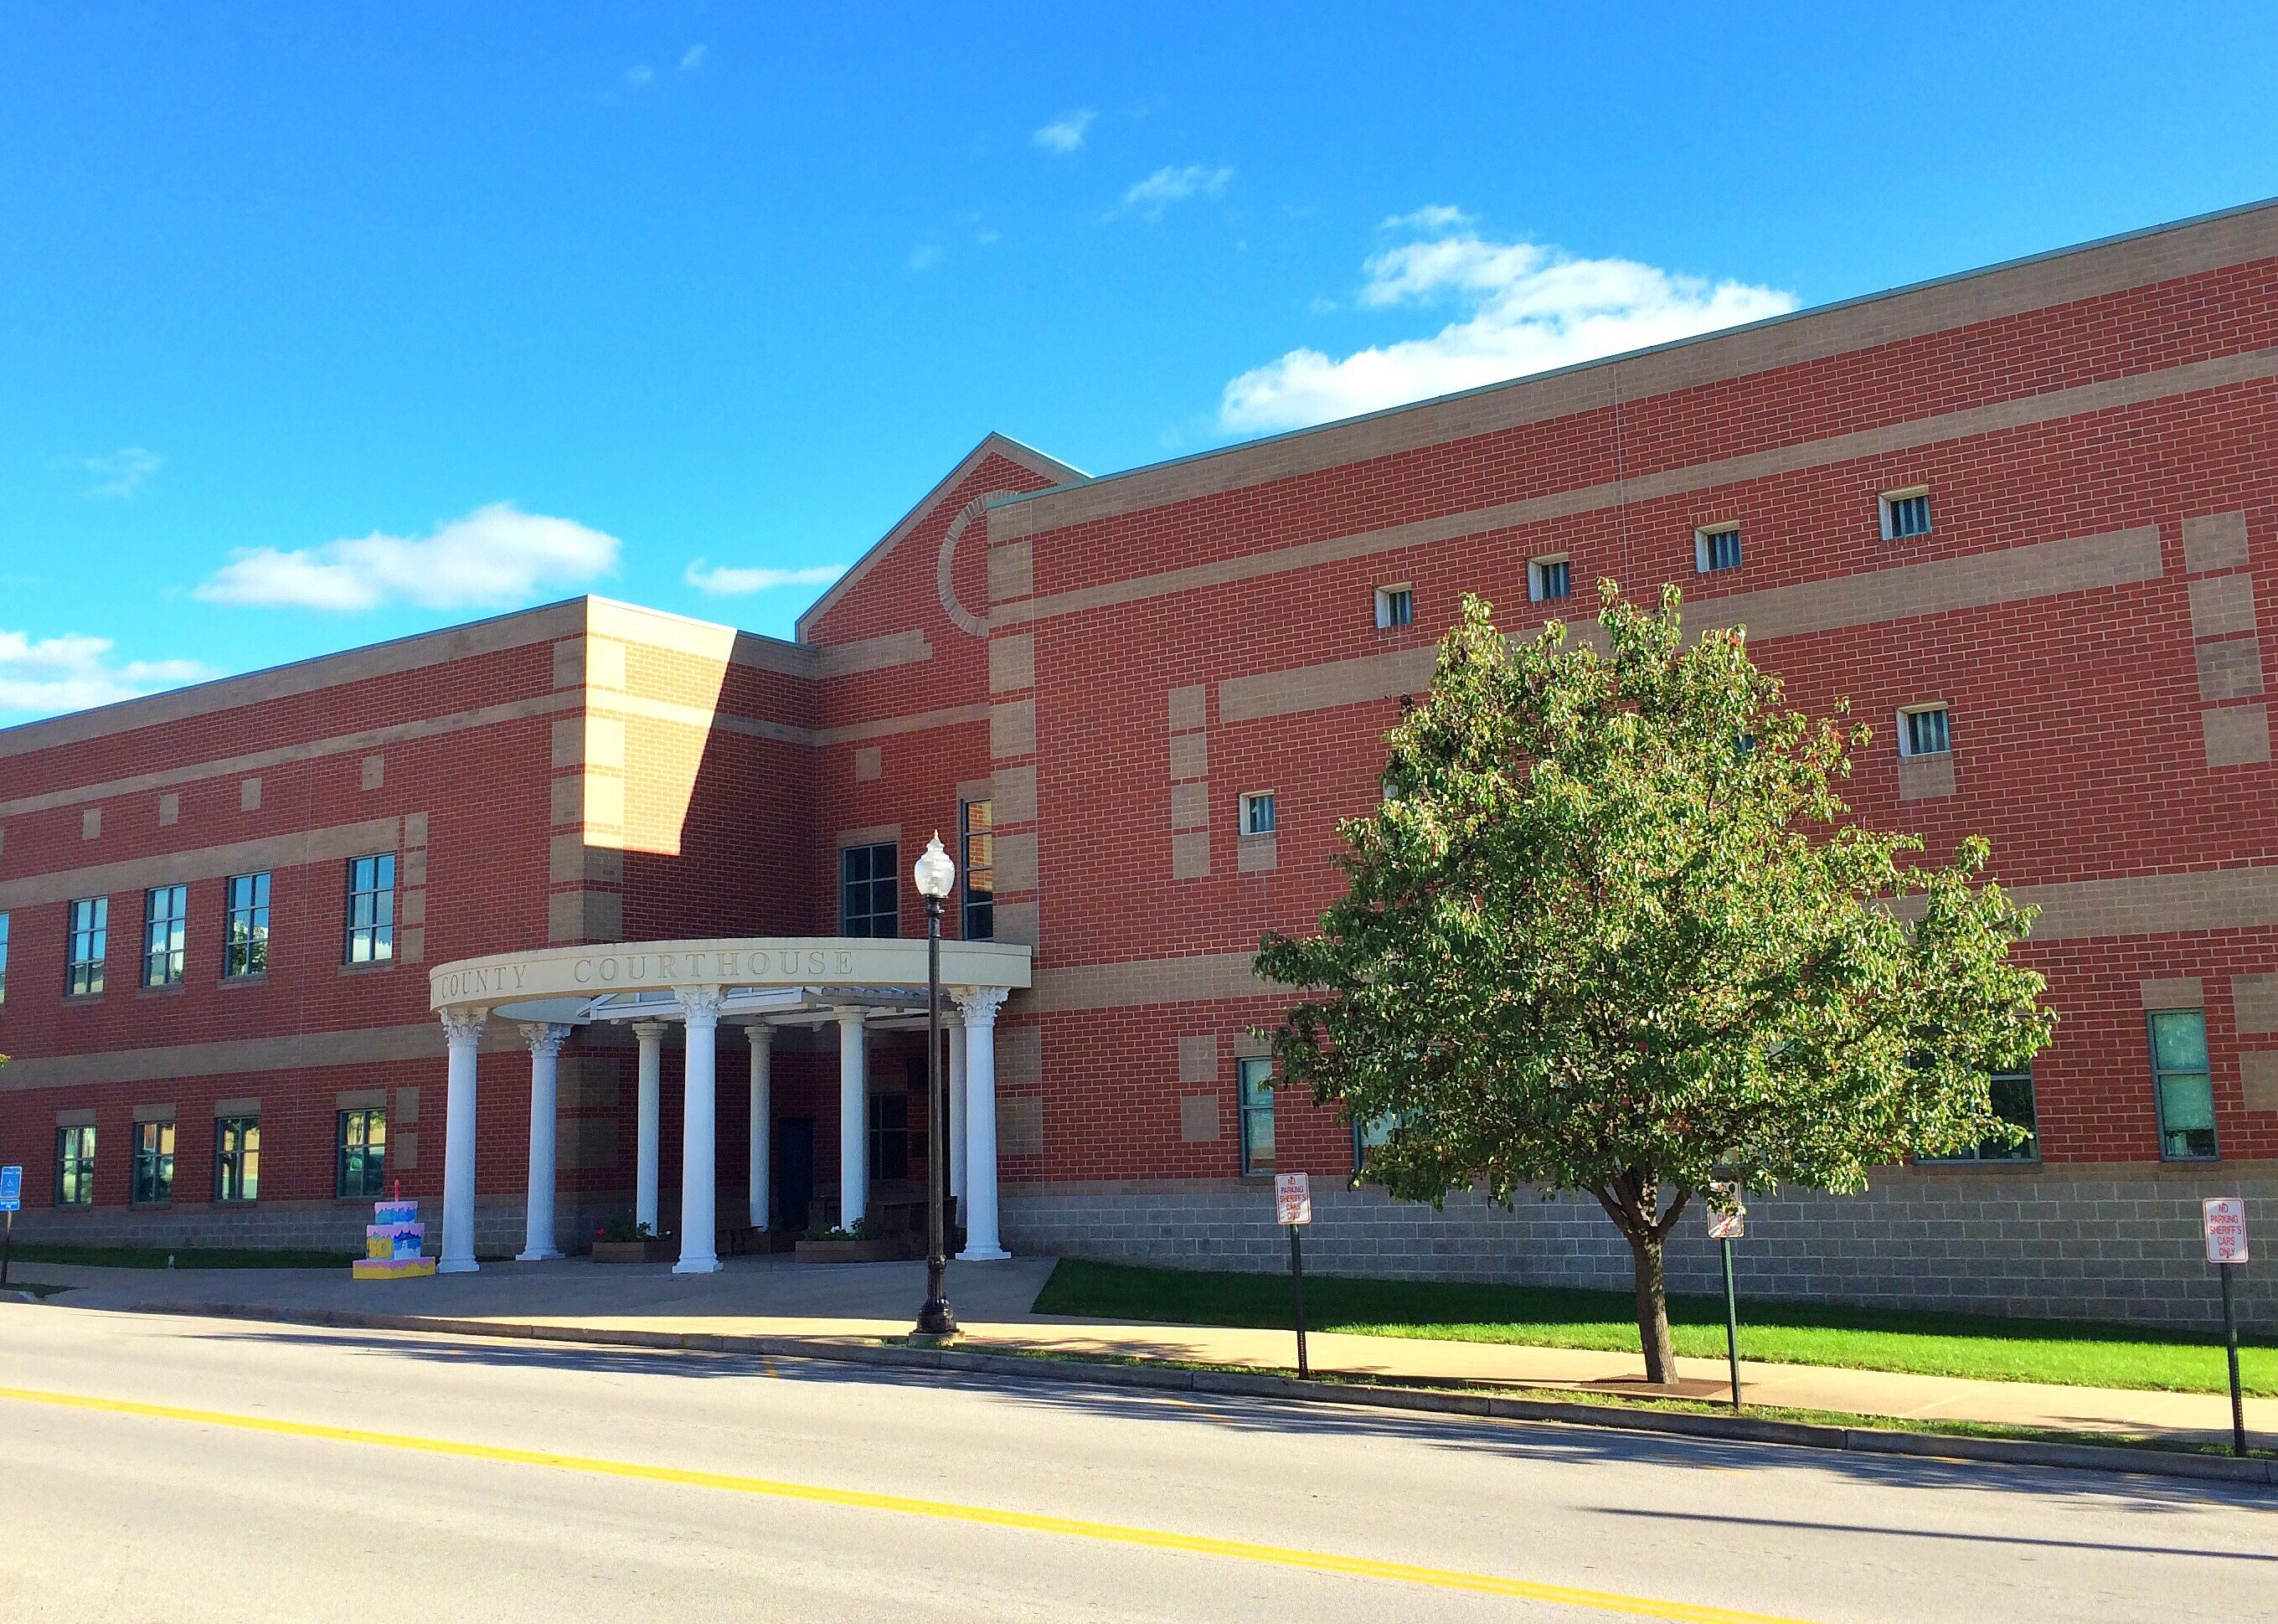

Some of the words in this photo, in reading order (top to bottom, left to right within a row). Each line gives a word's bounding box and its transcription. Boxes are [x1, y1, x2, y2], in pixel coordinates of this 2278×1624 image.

[441, 964, 528, 999] COUNTY
[573, 951, 853, 983] COURTHOUSE
[1281, 1186, 1304, 1194] PARKING
[2218, 1204, 2229, 1214] NO
[2210, 1214, 2239, 1224] PARKING
[2217, 1236, 2236, 1246] CARS
[2219, 1247, 2235, 1256] ONLY
